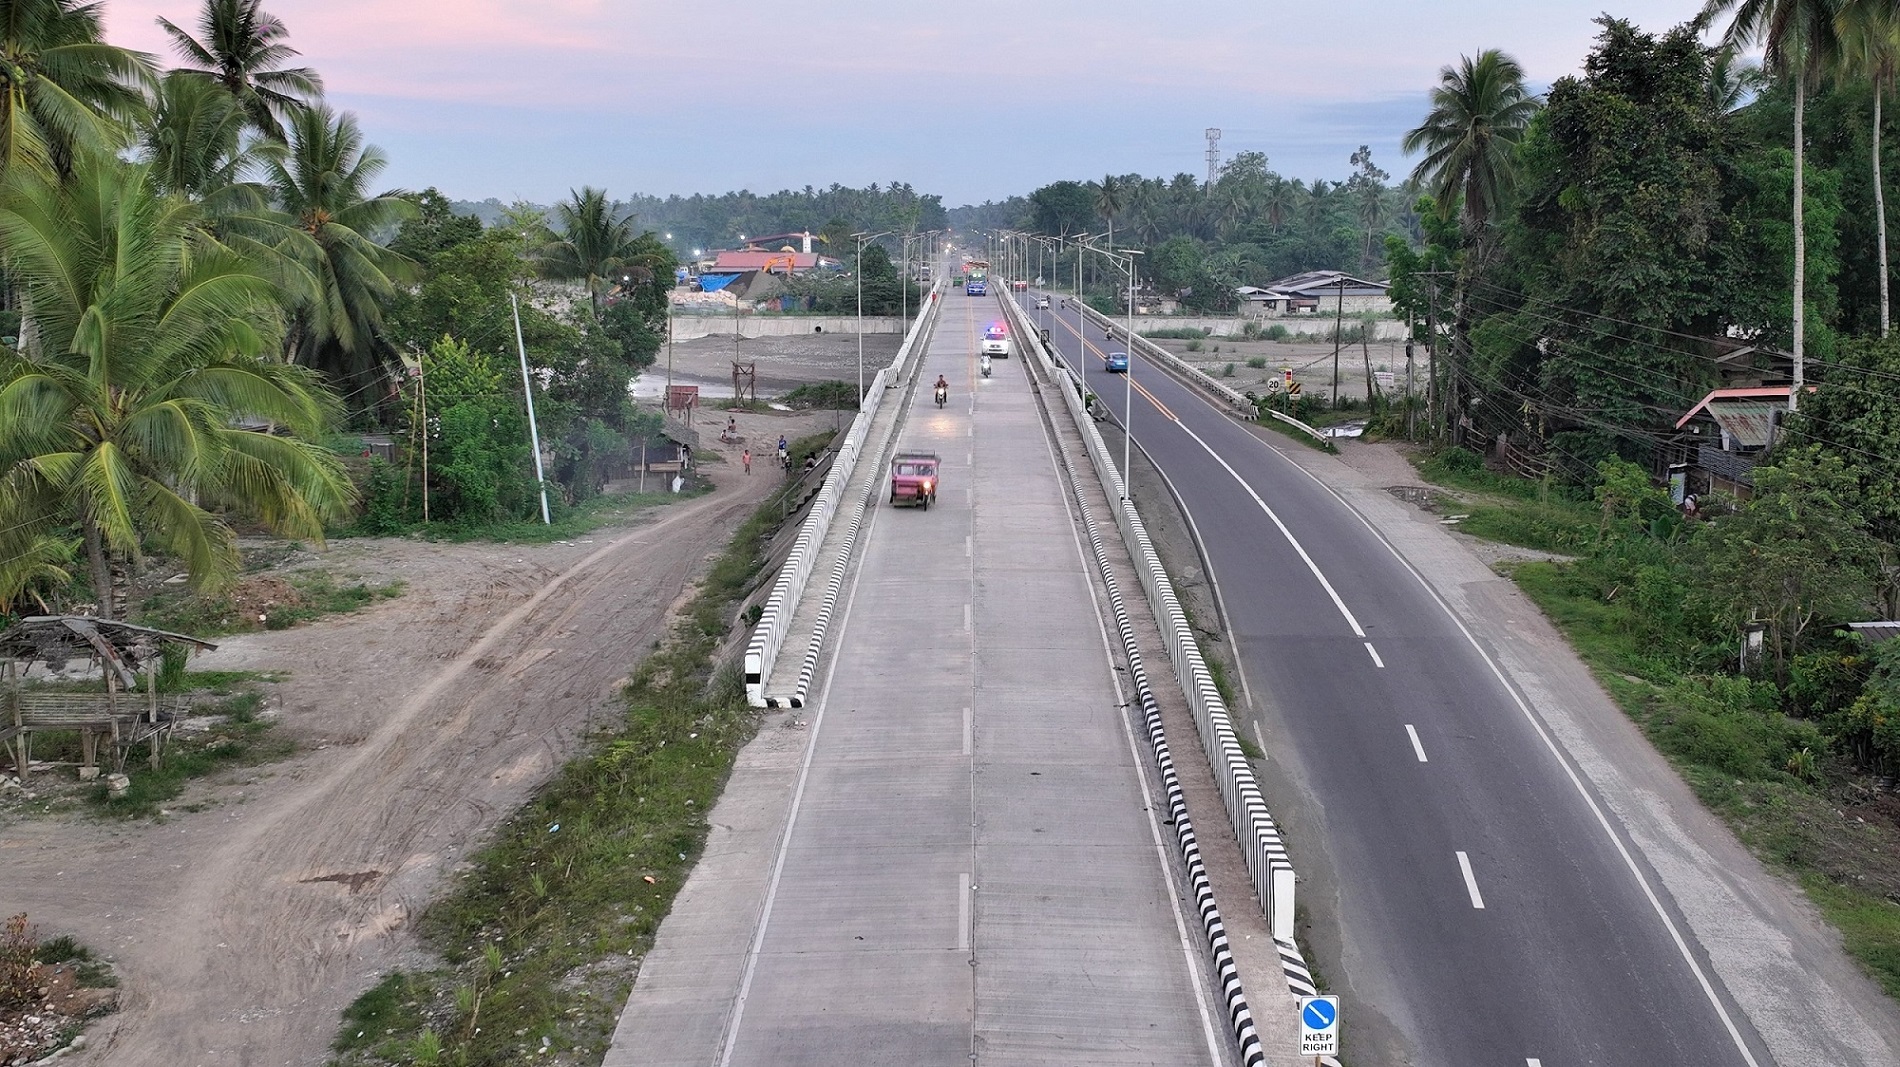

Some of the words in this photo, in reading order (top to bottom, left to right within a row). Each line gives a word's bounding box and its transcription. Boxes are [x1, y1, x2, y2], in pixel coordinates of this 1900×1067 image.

[1269, 380, 1279, 389] 20
[1305, 1033, 1333, 1041] KEEP
[1303, 1043, 1334, 1051] RIGHT
